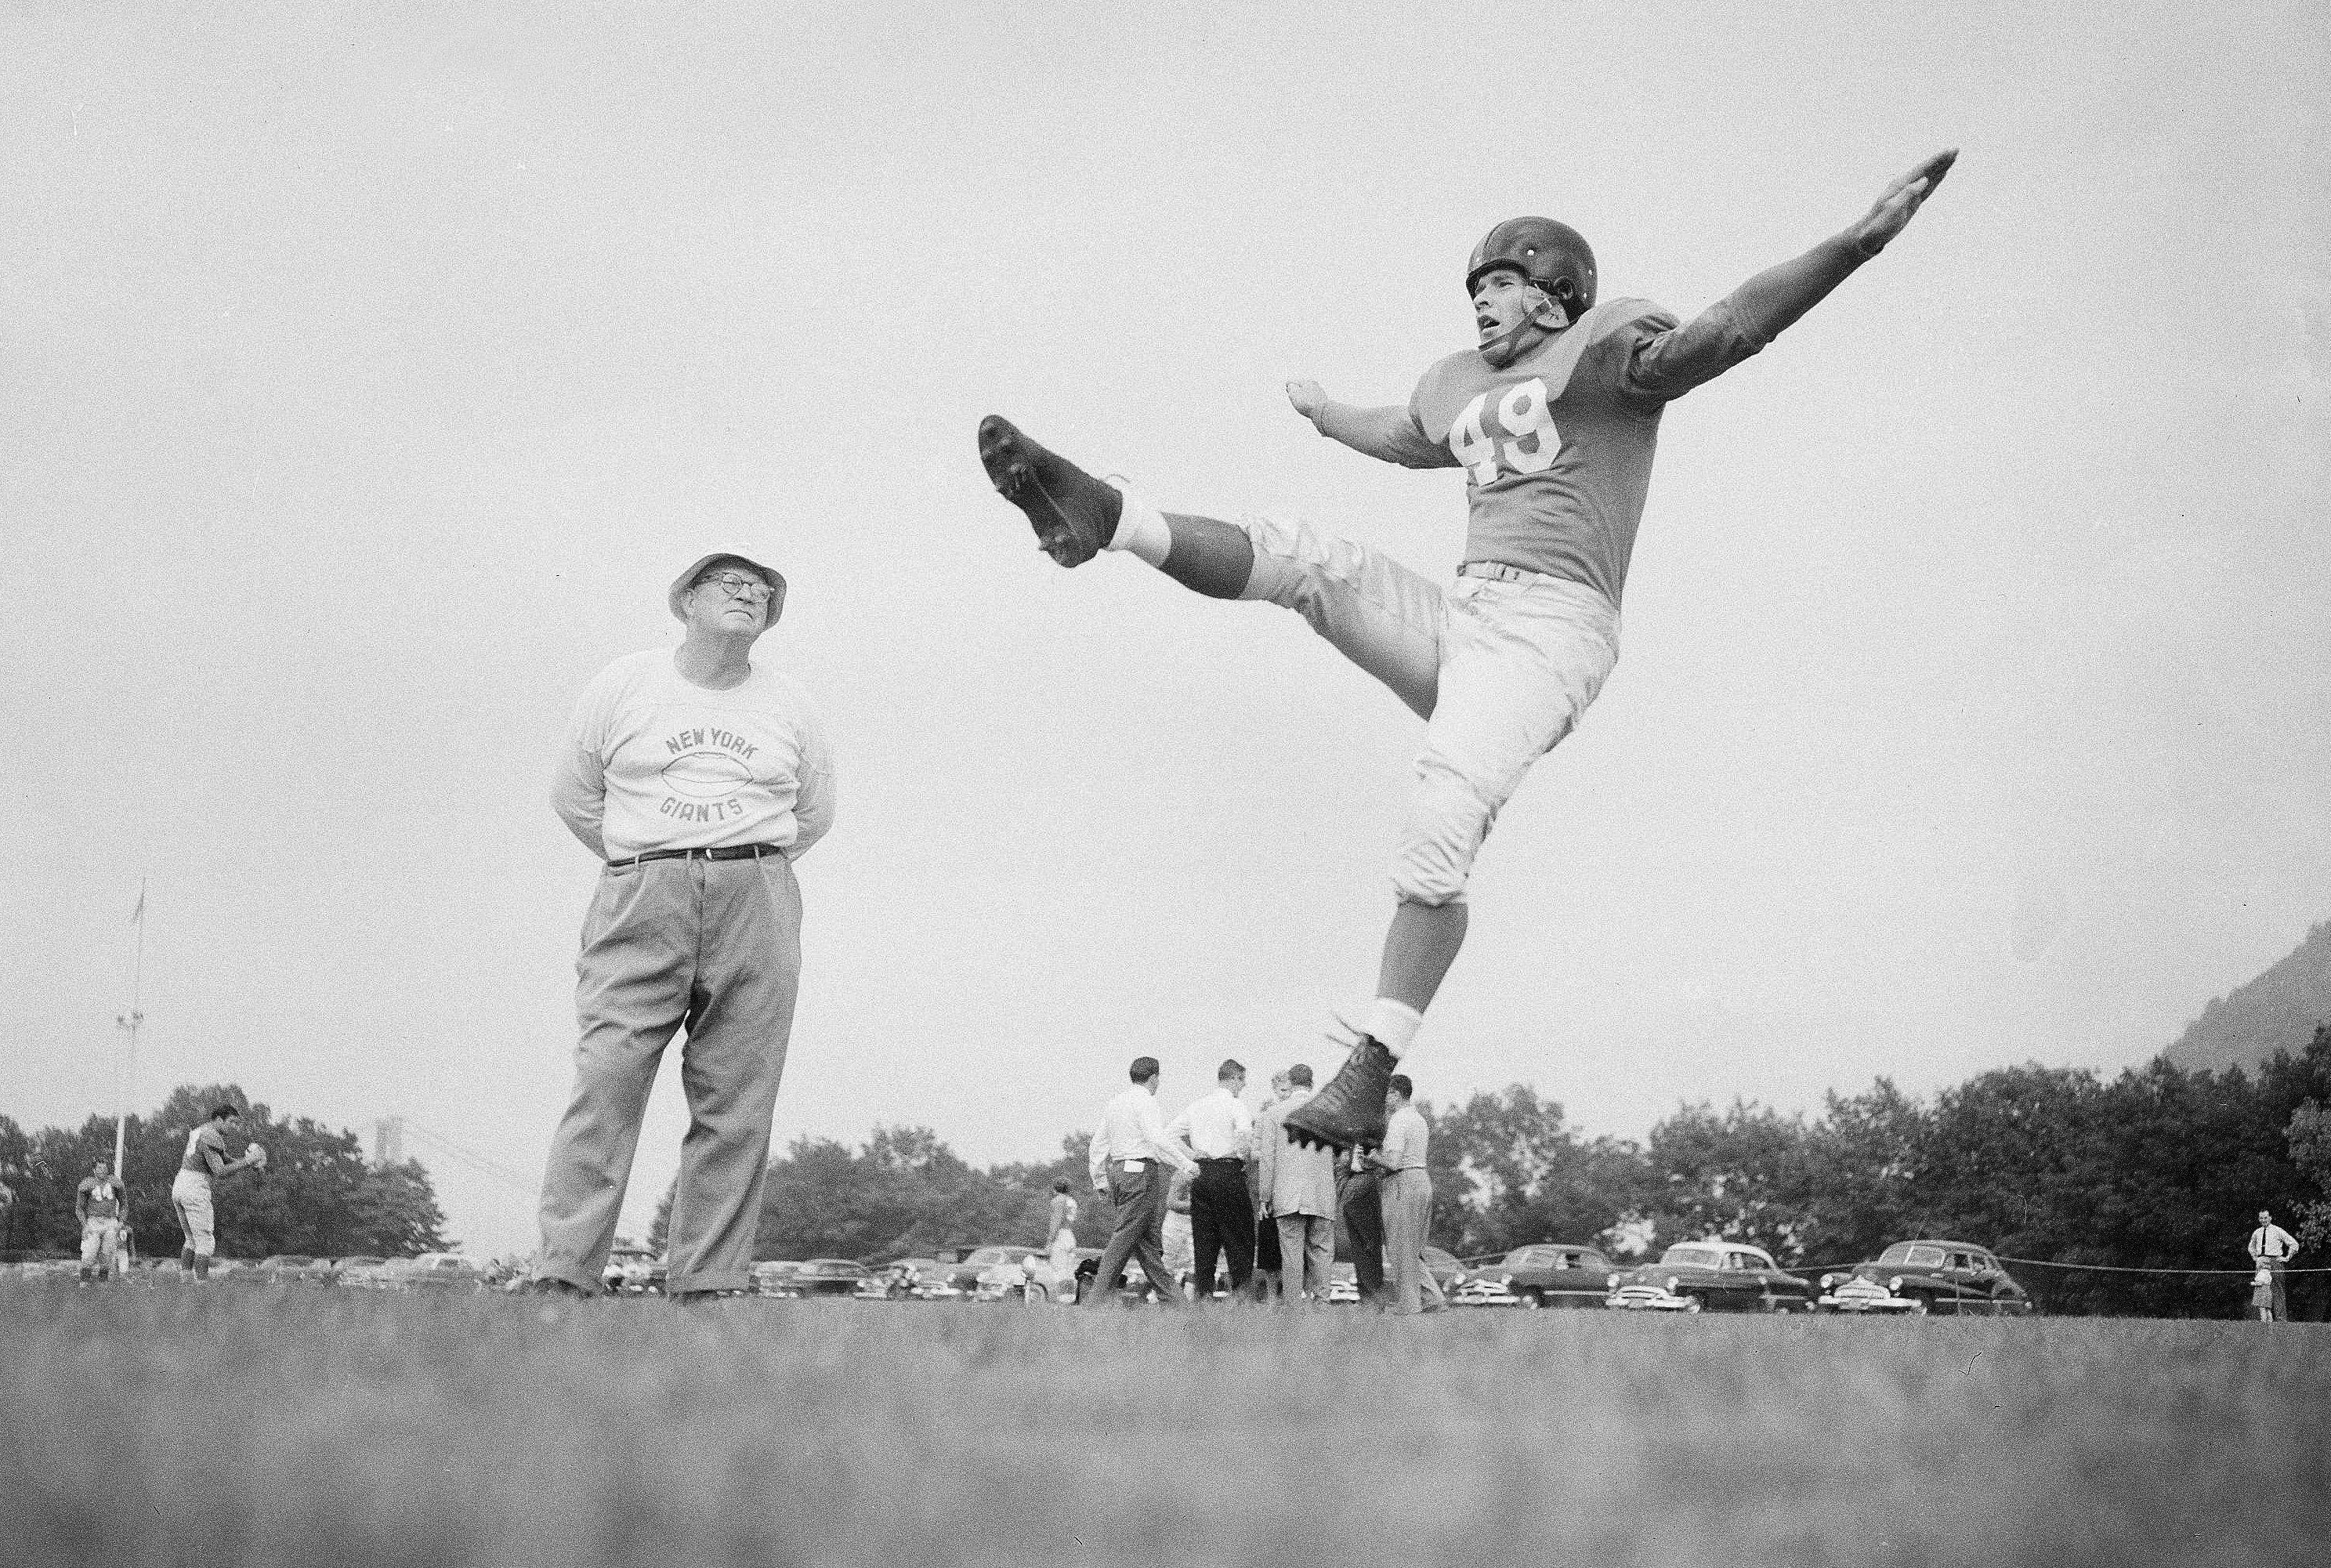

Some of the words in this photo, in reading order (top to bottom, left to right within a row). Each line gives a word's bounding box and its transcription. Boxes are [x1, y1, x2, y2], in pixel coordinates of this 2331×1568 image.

[1450, 376, 1562, 487] 49
[666, 727, 705, 755] NEW
[711, 727, 758, 759] YORK
[660, 796, 743, 822] GIANTS
